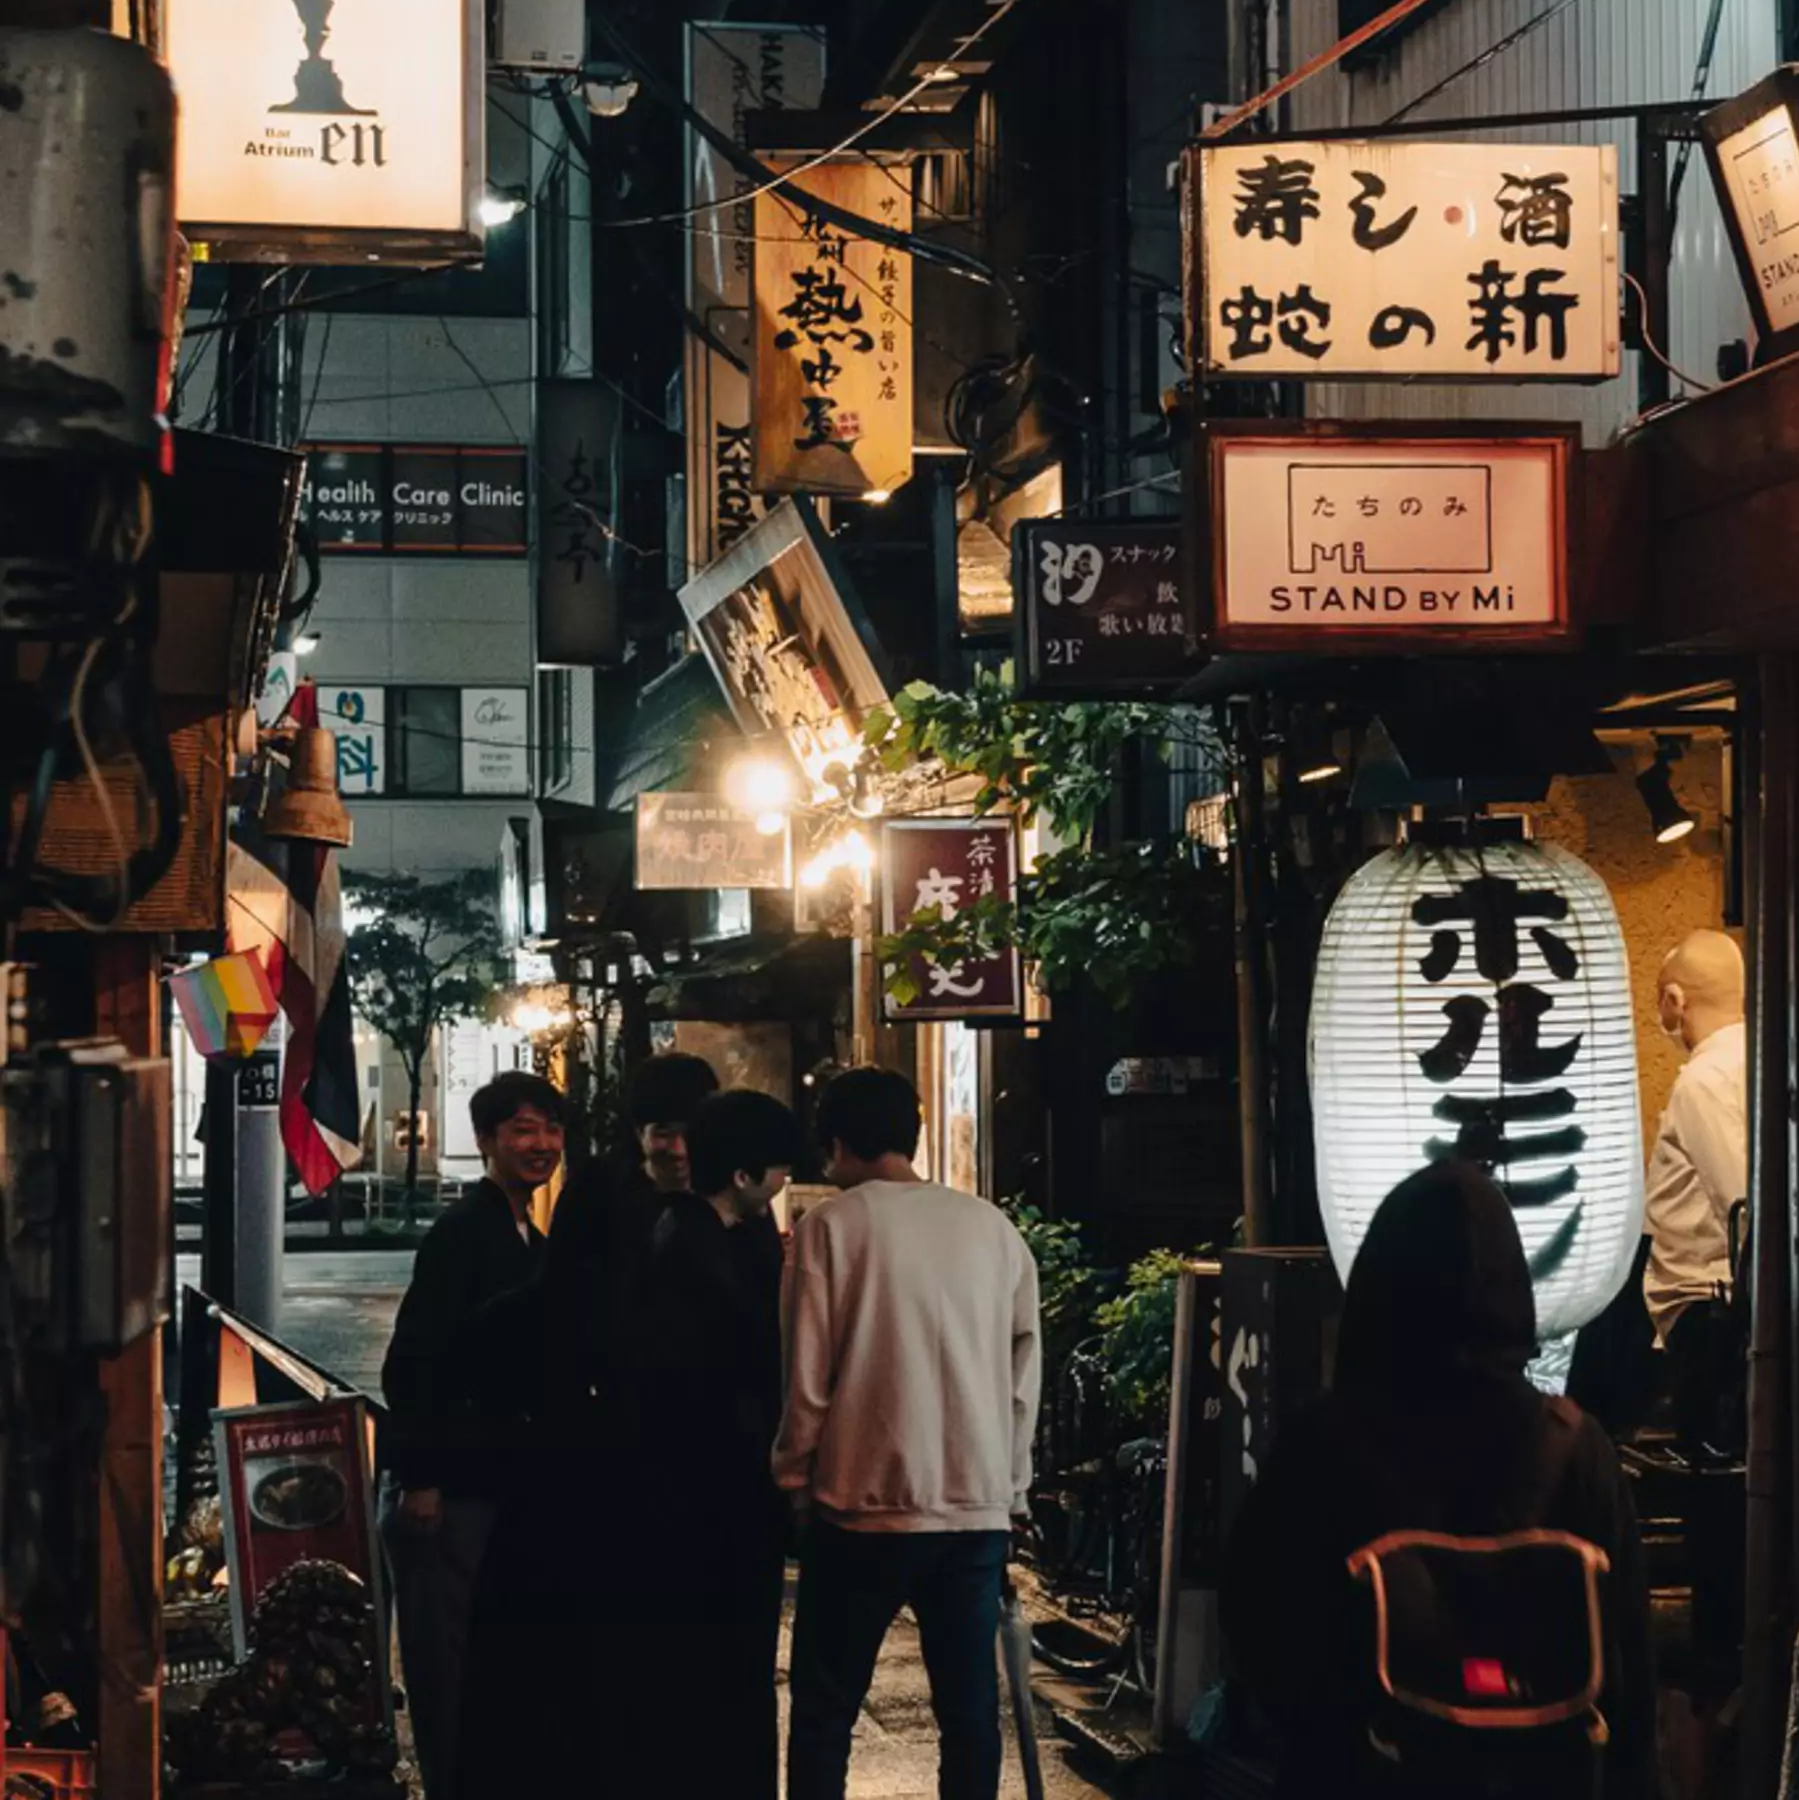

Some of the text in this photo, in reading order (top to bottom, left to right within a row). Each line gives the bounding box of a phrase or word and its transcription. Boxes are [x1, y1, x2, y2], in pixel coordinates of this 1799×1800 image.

[244, 122, 387, 167] Atrium en
[1220, 260, 1579, 363] 蛇の新
[392, 482, 450, 505] Care
[460, 483, 525, 506] Clinic
[1311, 495, 1469, 519] たちのみ
[394, 510, 453, 525] クリニック
[1109, 544, 1177, 565] スナック
[1269, 585, 1515, 613] STAND BY Mi
[1045, 637, 1084, 666] 2F
